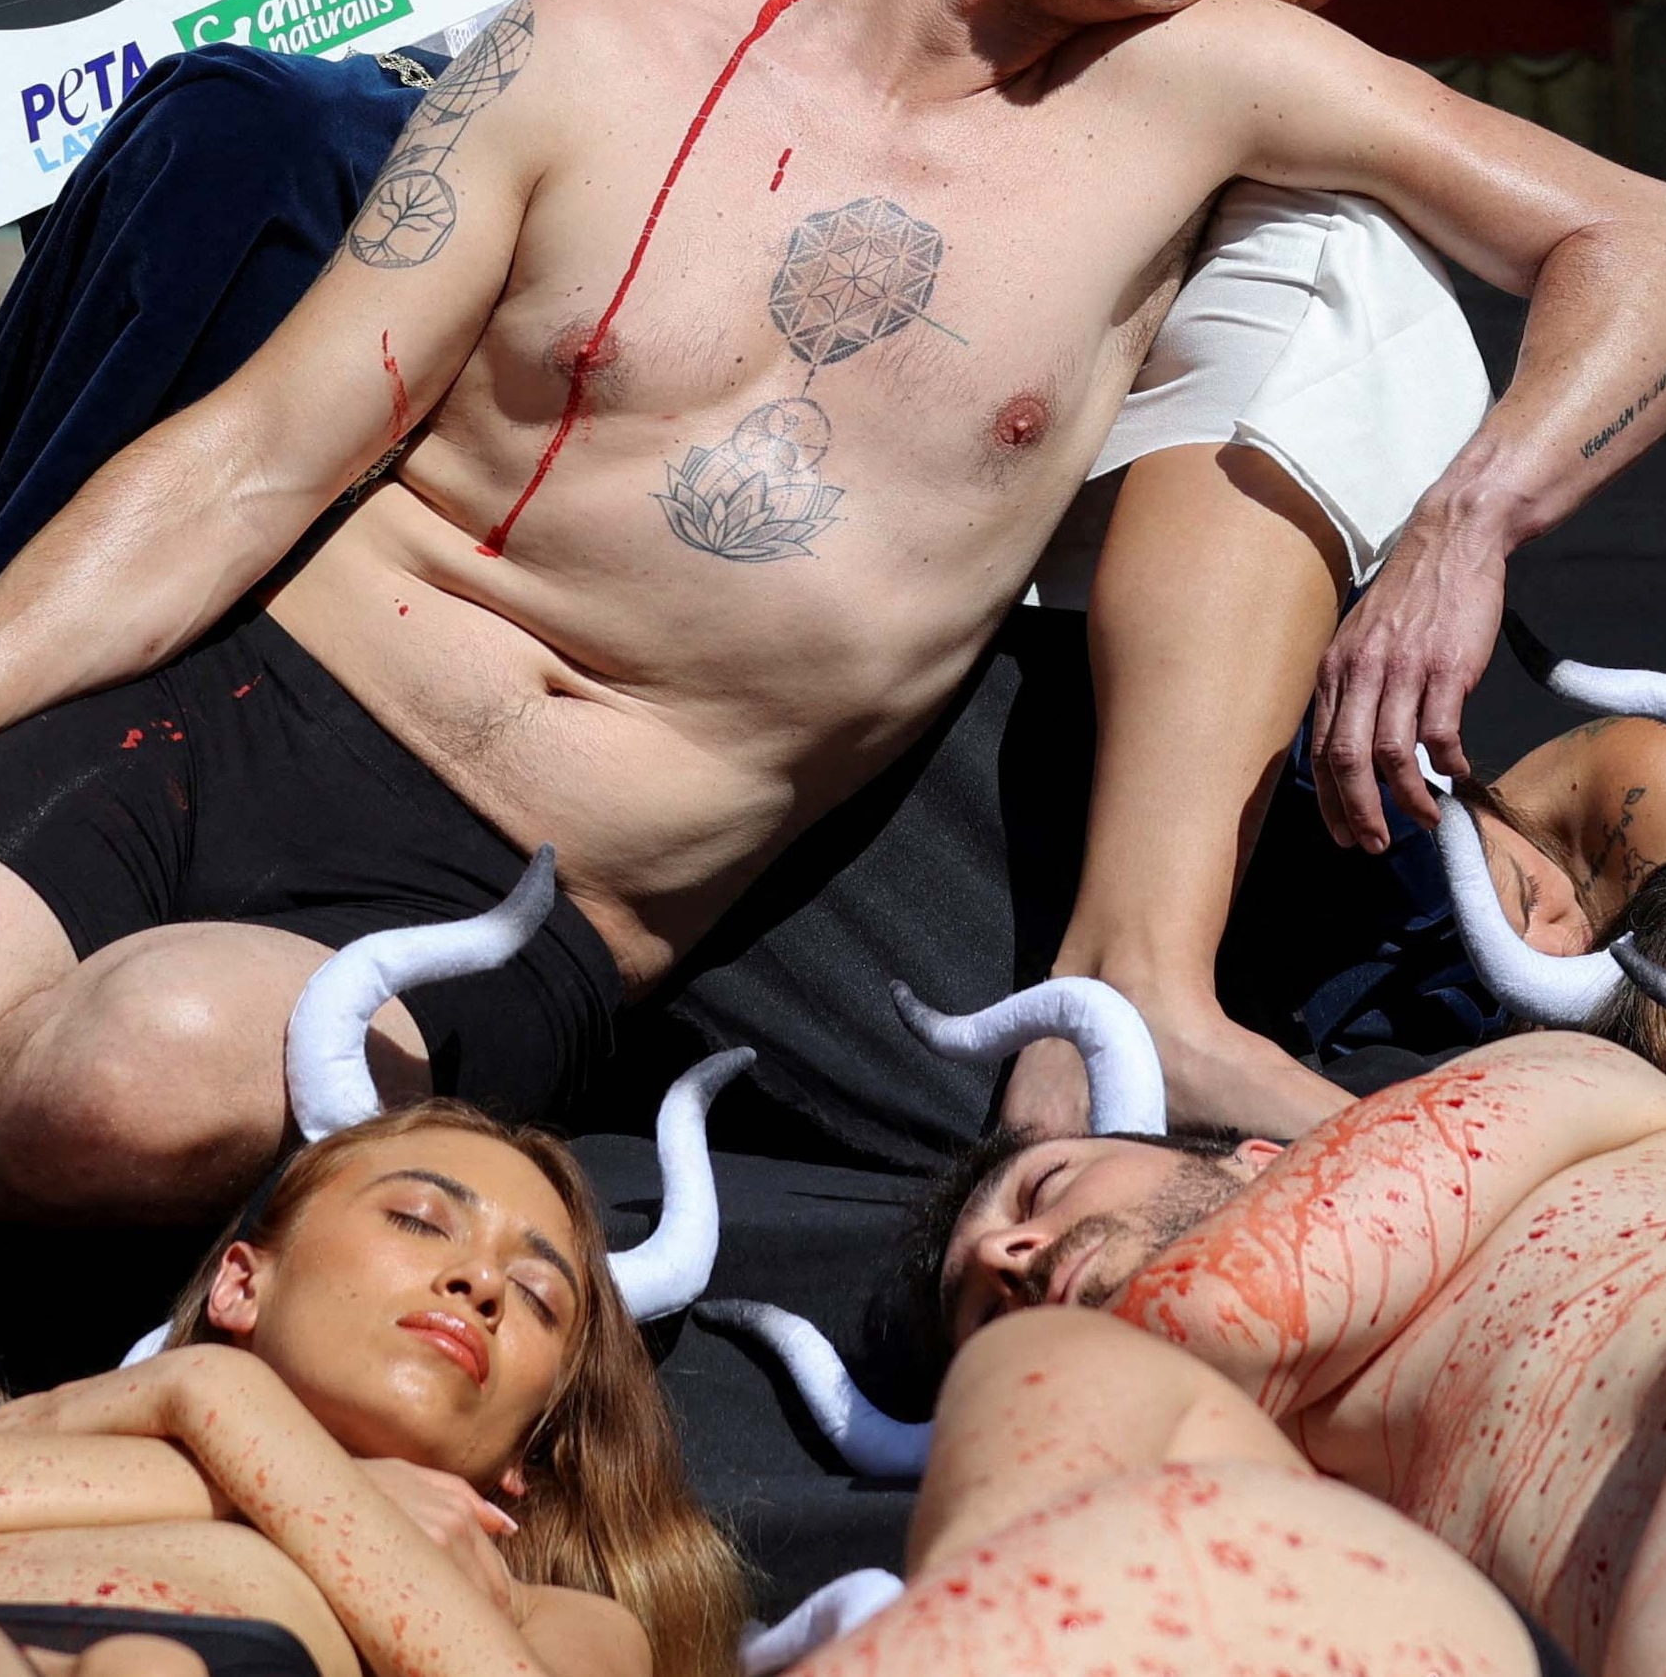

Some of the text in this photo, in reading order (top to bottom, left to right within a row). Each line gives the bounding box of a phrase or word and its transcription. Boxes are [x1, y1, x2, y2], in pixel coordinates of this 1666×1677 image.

[34, 117, 110, 174] LAT
[1579, 405, 1634, 459] VEGANISM
[1638, 393, 1650, 413] IS
